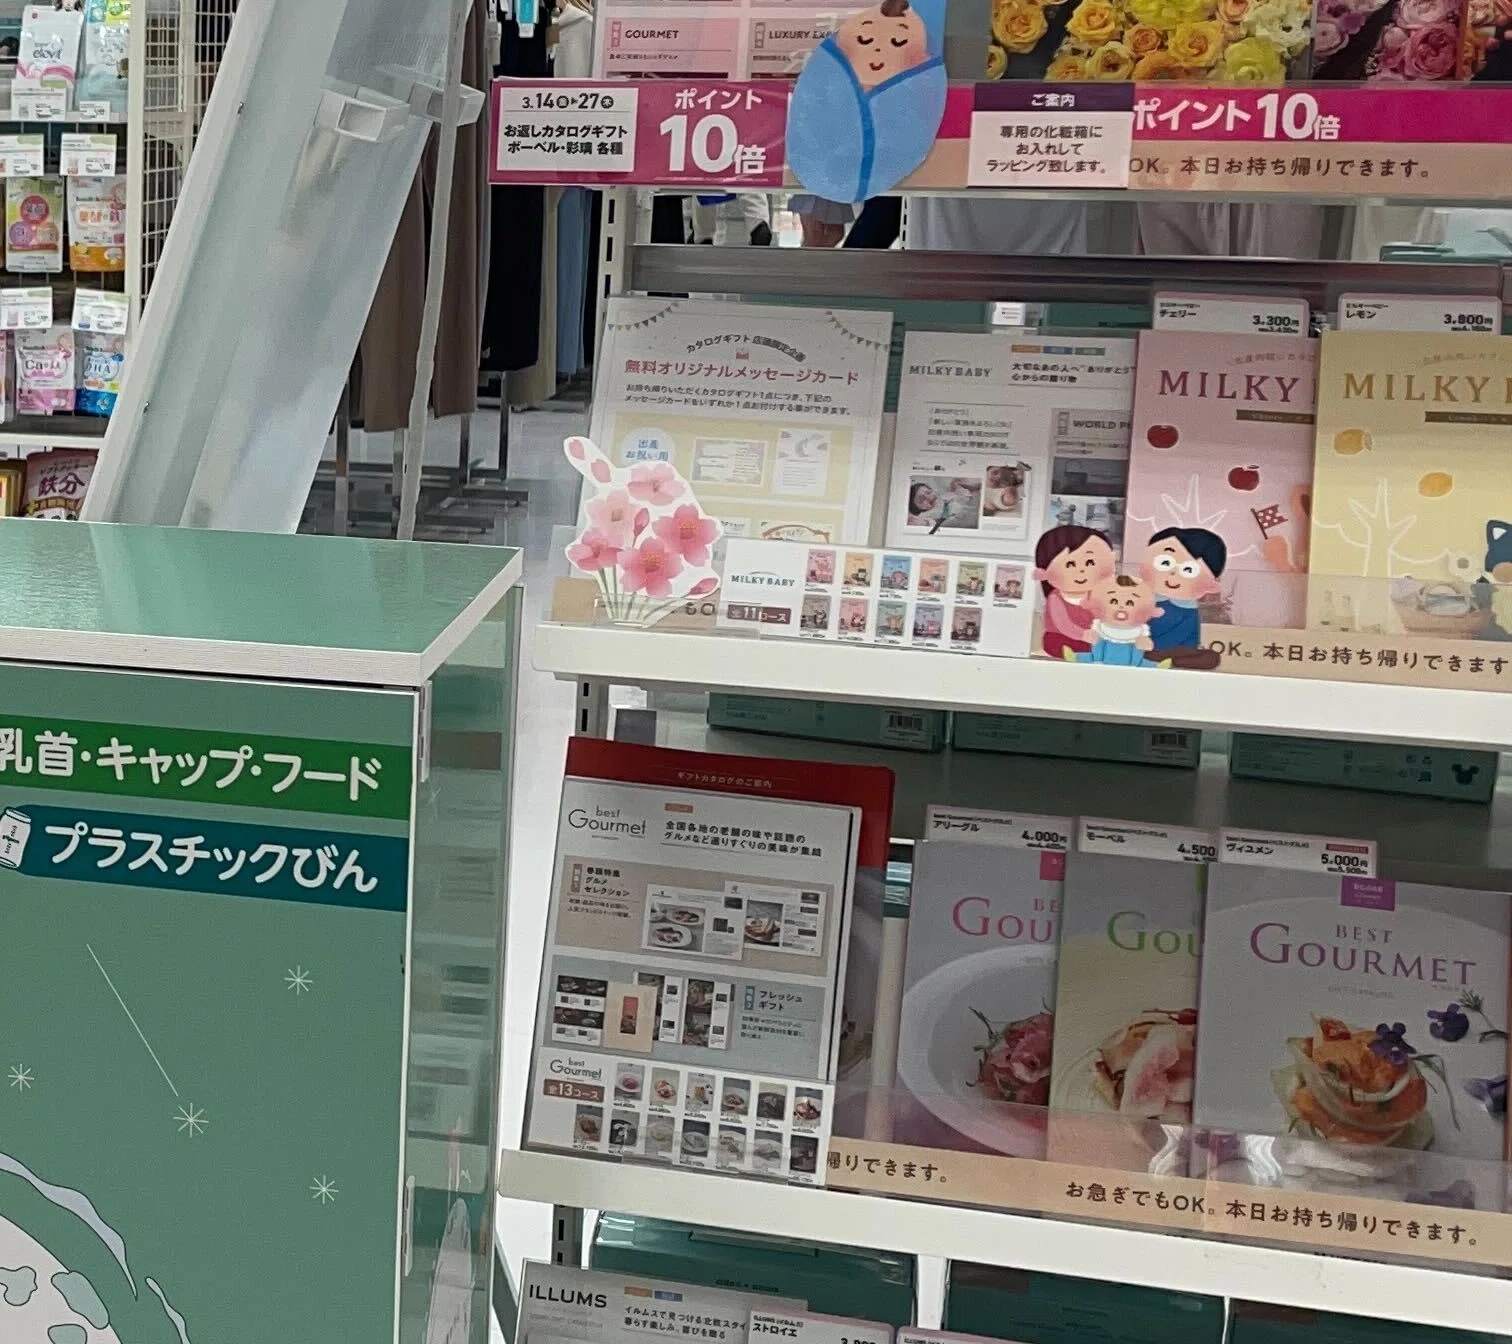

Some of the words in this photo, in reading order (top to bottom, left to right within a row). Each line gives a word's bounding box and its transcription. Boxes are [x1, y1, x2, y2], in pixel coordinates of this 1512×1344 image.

[625, 29, 679, 39] GOURMET
[768, 30, 810, 39] LUXURY
[674, 87, 764, 112] ポイント
[1031, 92, 1075, 108] ご案内
[503, 123, 628, 140] お返しカタログギフト
[1000, 124, 1103, 140] 専用の化粧箱に
[597, 140, 624, 157] 各種
[659, 113, 767, 175] 10倍
[1016, 142, 1083, 156] お入れして
[987, 158, 1108, 174] ラッピング致します。
[1159, 309, 1197, 319] チェリー
[1252, 314, 1299, 327] 3,300円
[1346, 309, 1377, 320] レモン
[625, 359, 859, 385] 無料オリジナルメッセージカード
[909, 364, 952, 376] MILKY
[955, 367, 993, 377] BABY
[1159, 369, 1300, 403] MILKY
[1343, 372, 1491, 404] MILKY
[1073, 419, 1116, 429] WORLD
[38, 472, 87, 497] 鉄分
[731, 575, 764, 586] MILKY
[766, 577, 795, 588] BABY
[595, 805, 620, 818] best
[568, 808, 646, 835] Gourmet
[44, 821, 378, 893] プラスチックびん
[1336, 924, 1393, 944] BEST
[1250, 922, 1476, 985] GOURMET
[758, 1001, 785, 1012] ギフト
[550, 1059, 603, 1079] Gourmet
[529, 1284, 607, 1308] ILLUMS
[752, 1323, 798, 1338] ストロイエ
